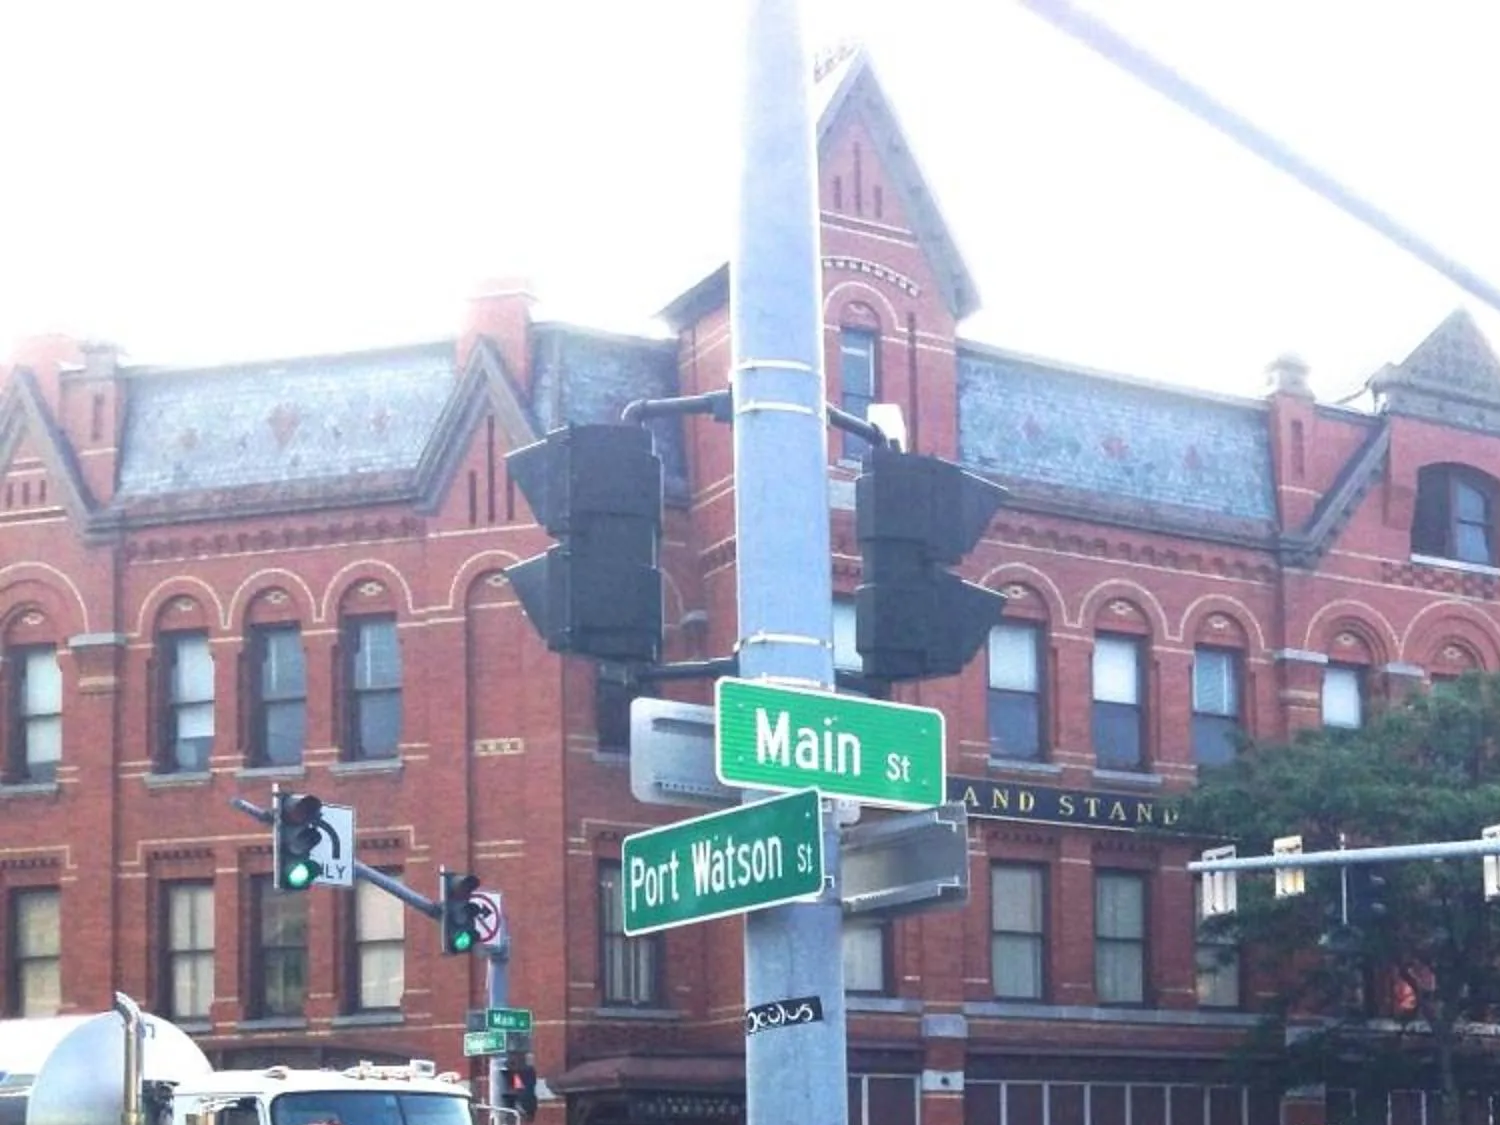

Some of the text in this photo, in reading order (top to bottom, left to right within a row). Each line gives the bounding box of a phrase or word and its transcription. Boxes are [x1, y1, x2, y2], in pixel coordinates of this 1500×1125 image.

[754, 707, 912, 783] Main St
[1058, 795, 1181, 826] STAND
[630, 834, 814, 913] Port Watson St
